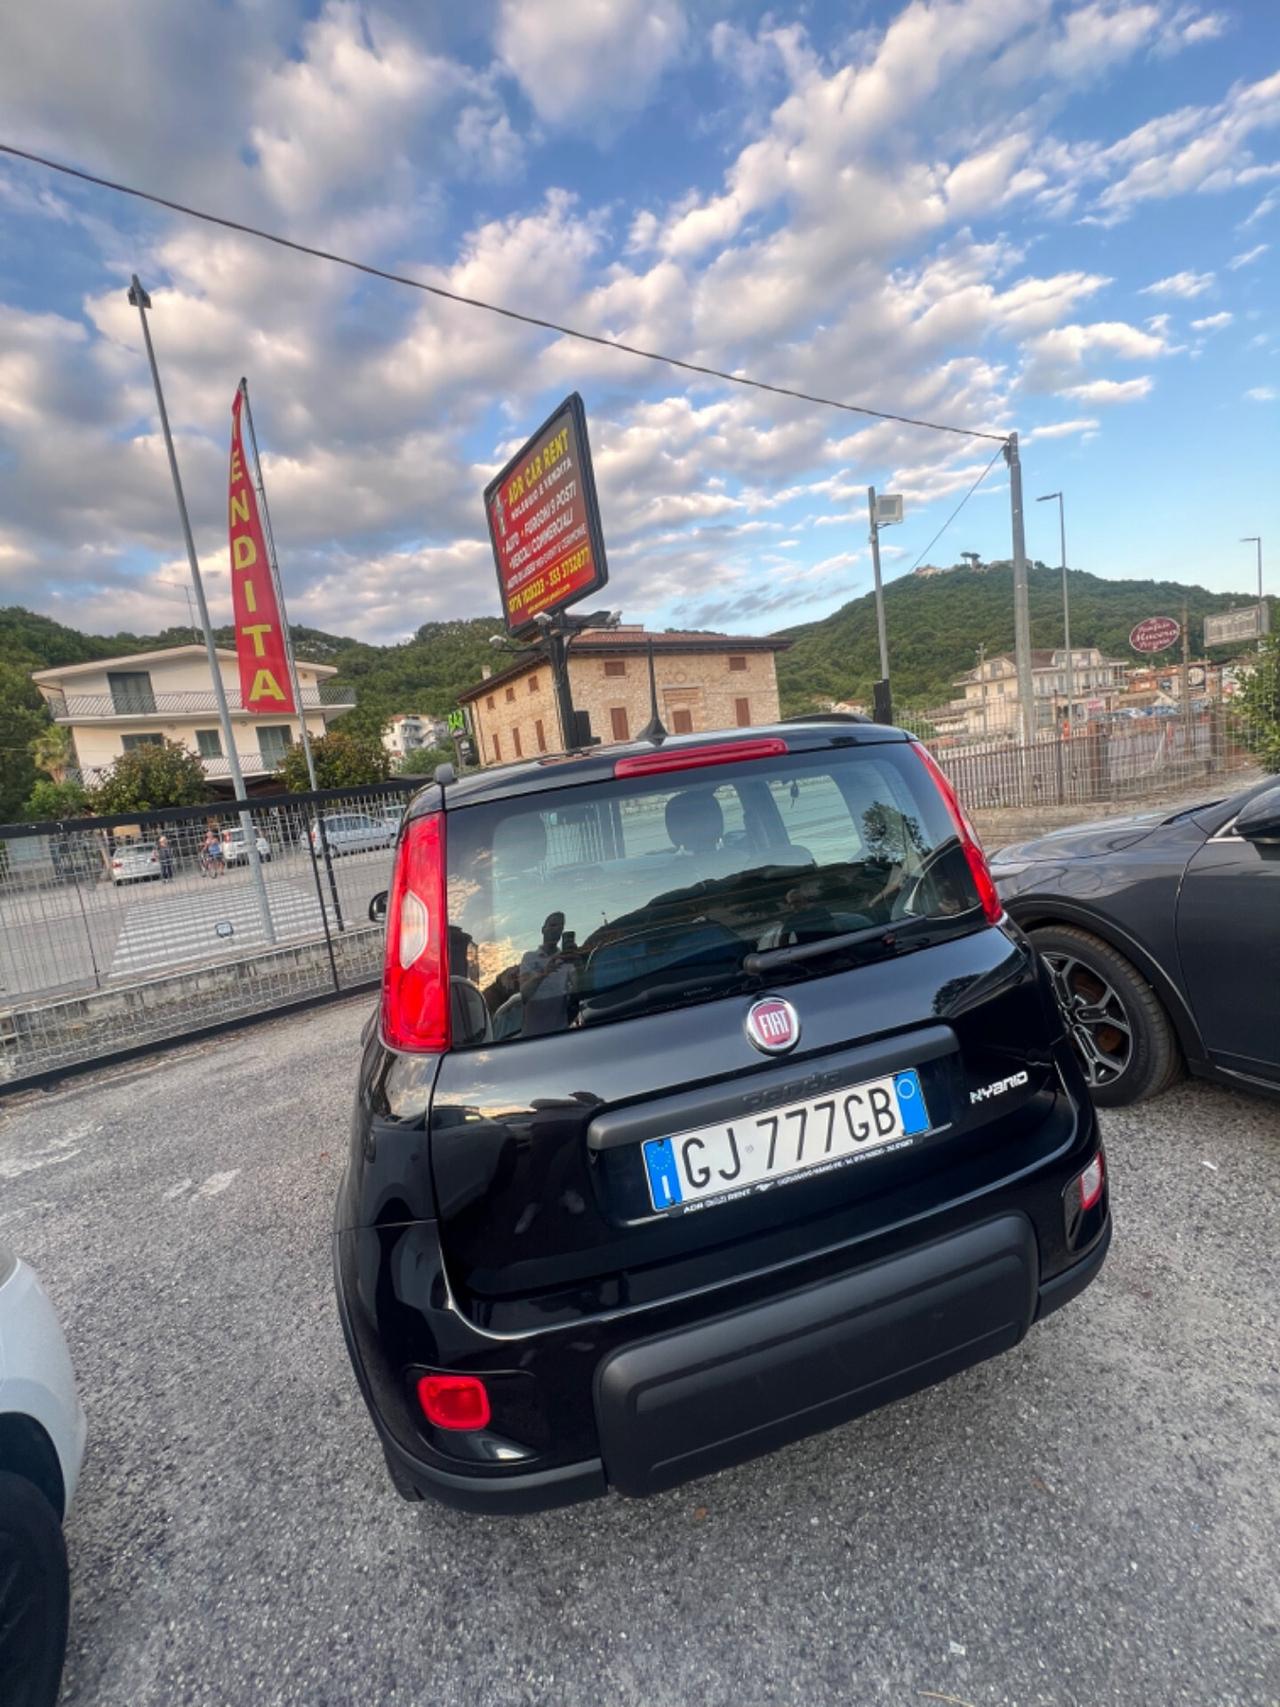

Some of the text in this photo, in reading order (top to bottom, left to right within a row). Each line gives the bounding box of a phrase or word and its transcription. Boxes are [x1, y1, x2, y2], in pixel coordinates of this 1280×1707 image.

[508, 427, 569, 507] ADR CAR RENT
[544, 457, 573, 489] VENDITA
[556, 480, 577, 511] POSTI
[759, 1010, 790, 1039] FIAT
[682, 1128, 742, 1189] GJ
[756, 1087, 897, 1170] 777GB
